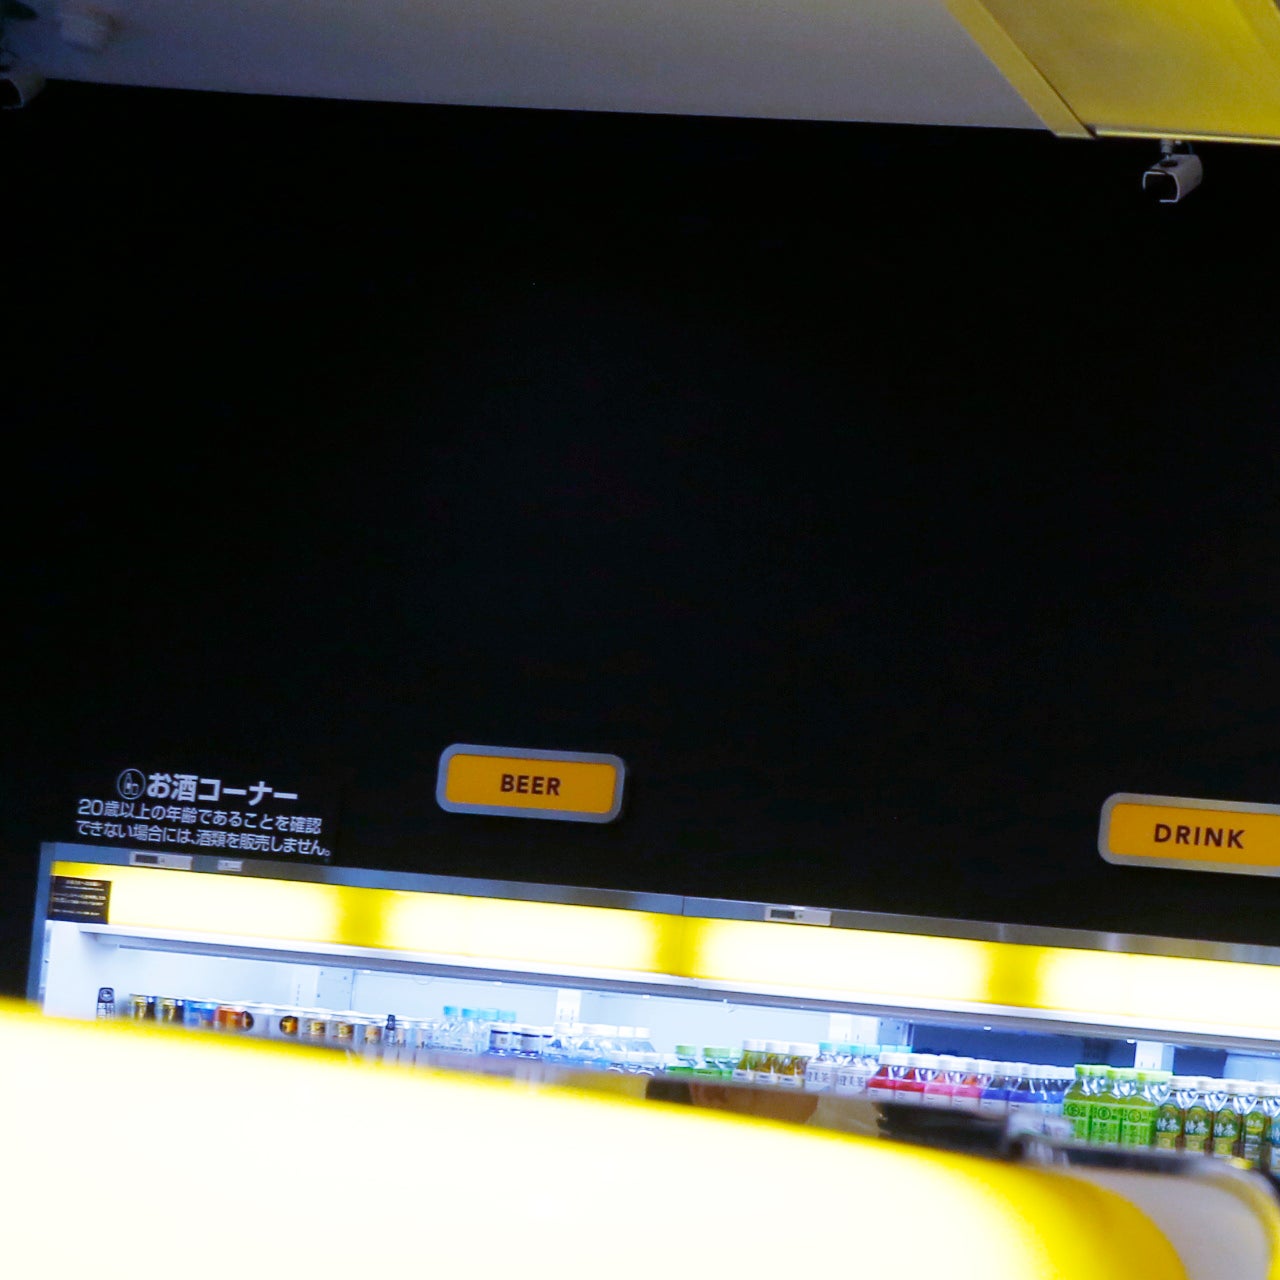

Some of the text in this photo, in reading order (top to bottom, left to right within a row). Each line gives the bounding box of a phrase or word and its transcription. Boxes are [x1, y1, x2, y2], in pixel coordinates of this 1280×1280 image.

[147, 772, 298, 806] お酒コーナー
[500, 774, 561, 796] BEER
[77, 799, 323, 835] 20歳以上の年齢であることを確認
[76, 820, 331, 857] できない場合には、酒類を販売しません。
[1154, 823, 1245, 849] DRINK
